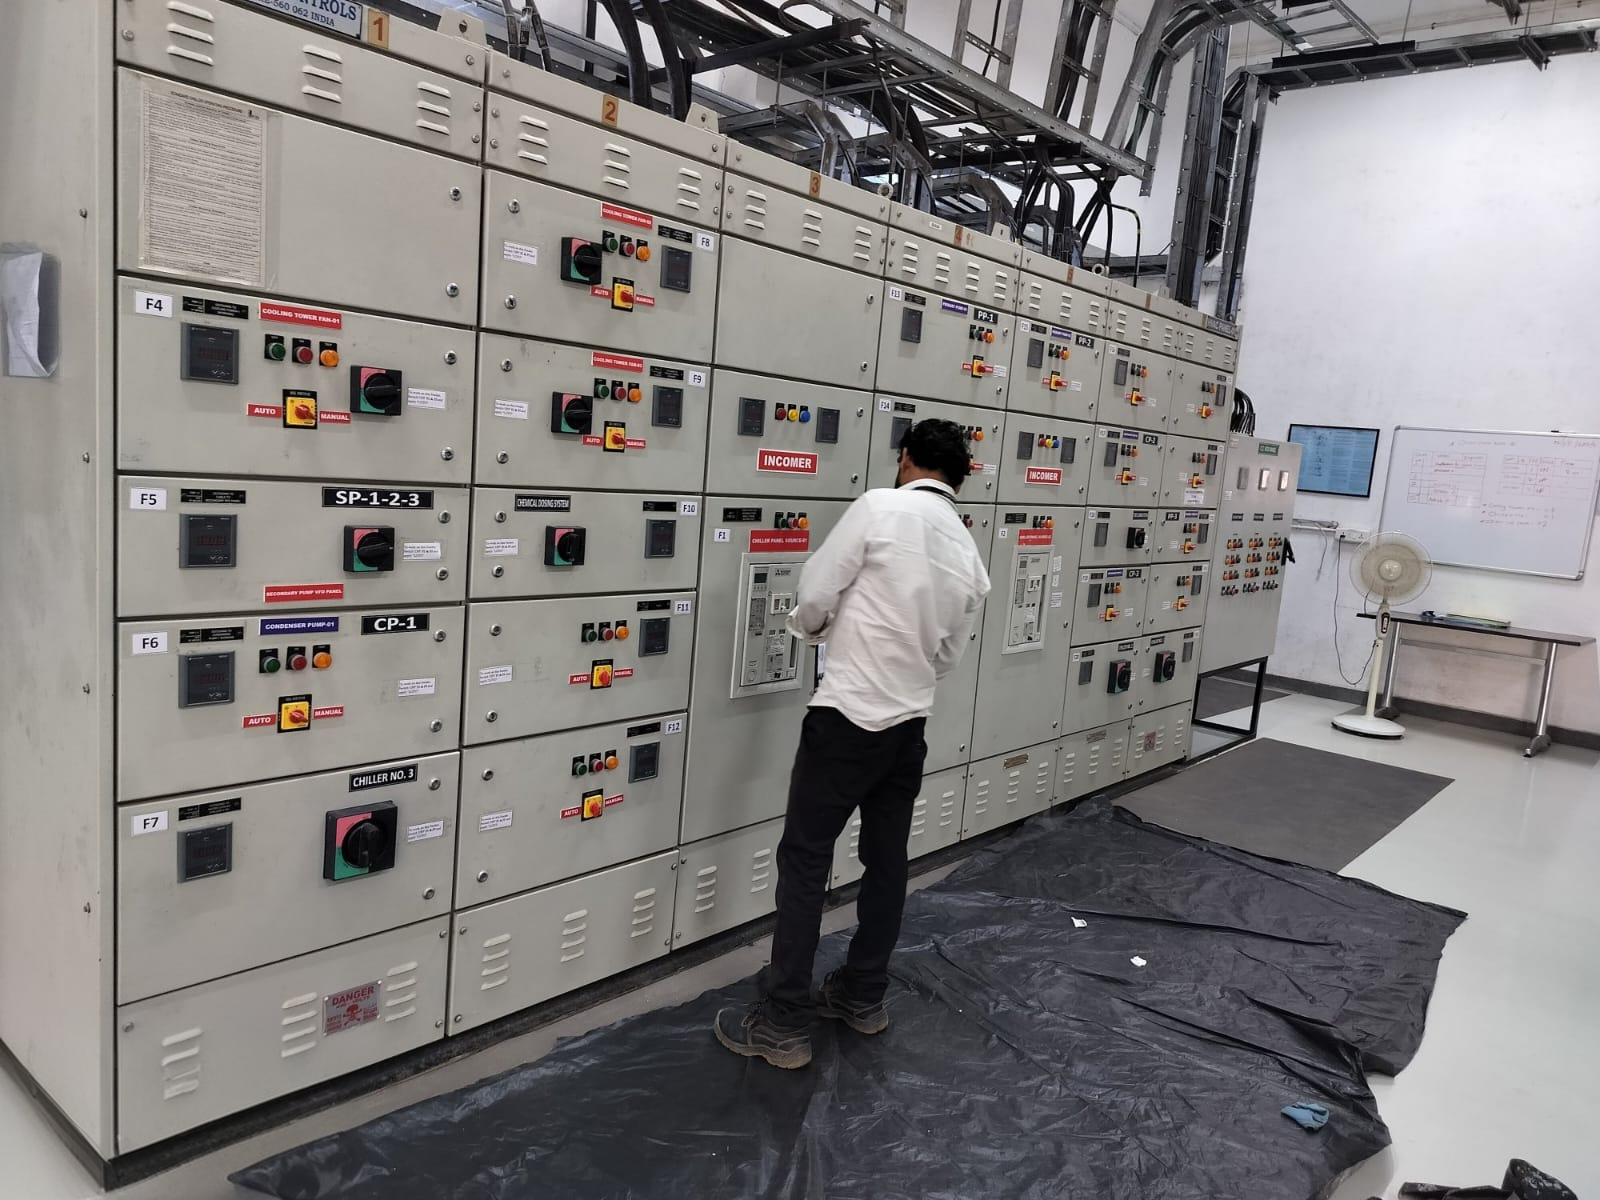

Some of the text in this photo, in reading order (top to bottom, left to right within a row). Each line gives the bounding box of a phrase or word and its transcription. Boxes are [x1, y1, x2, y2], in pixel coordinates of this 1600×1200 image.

[292, 5, 309, 17] 062
[311, 11, 335, 27] INDIA
[373, 17, 384, 41] 1
[605, 101, 616, 122] 2
[812, 176, 820, 194] 3
[146, 297, 163, 312] F4
[262, 307, 340, 325] COOLING TOWER FAN-01
[978, 310, 994, 322] PP-1
[693, 374, 702, 384] F9
[254, 406, 350, 421] AUTO MANUAL
[763, 454, 812, 469] INCOMER
[1029, 471, 1058, 481] INCOMER
[140, 493, 157, 505] F5
[335, 490, 420, 507] SP-1-2-3
[683, 504, 695, 513] F10
[677, 603, 689, 612] F11
[307, 621, 335, 629] PUMP-01
[373, 616, 417, 631] CP-1
[142, 637, 159, 649] F6
[573, 674, 588, 682] AUTO
[248, 707, 343, 725] AUTO MANUAL
[667, 722, 680, 732] F12
[352, 769, 414, 788] CHILLER NO. 3
[564, 808, 579, 818] AUTO
[143, 816, 159, 830] F7
[332, 986, 375, 1006] DANGER
